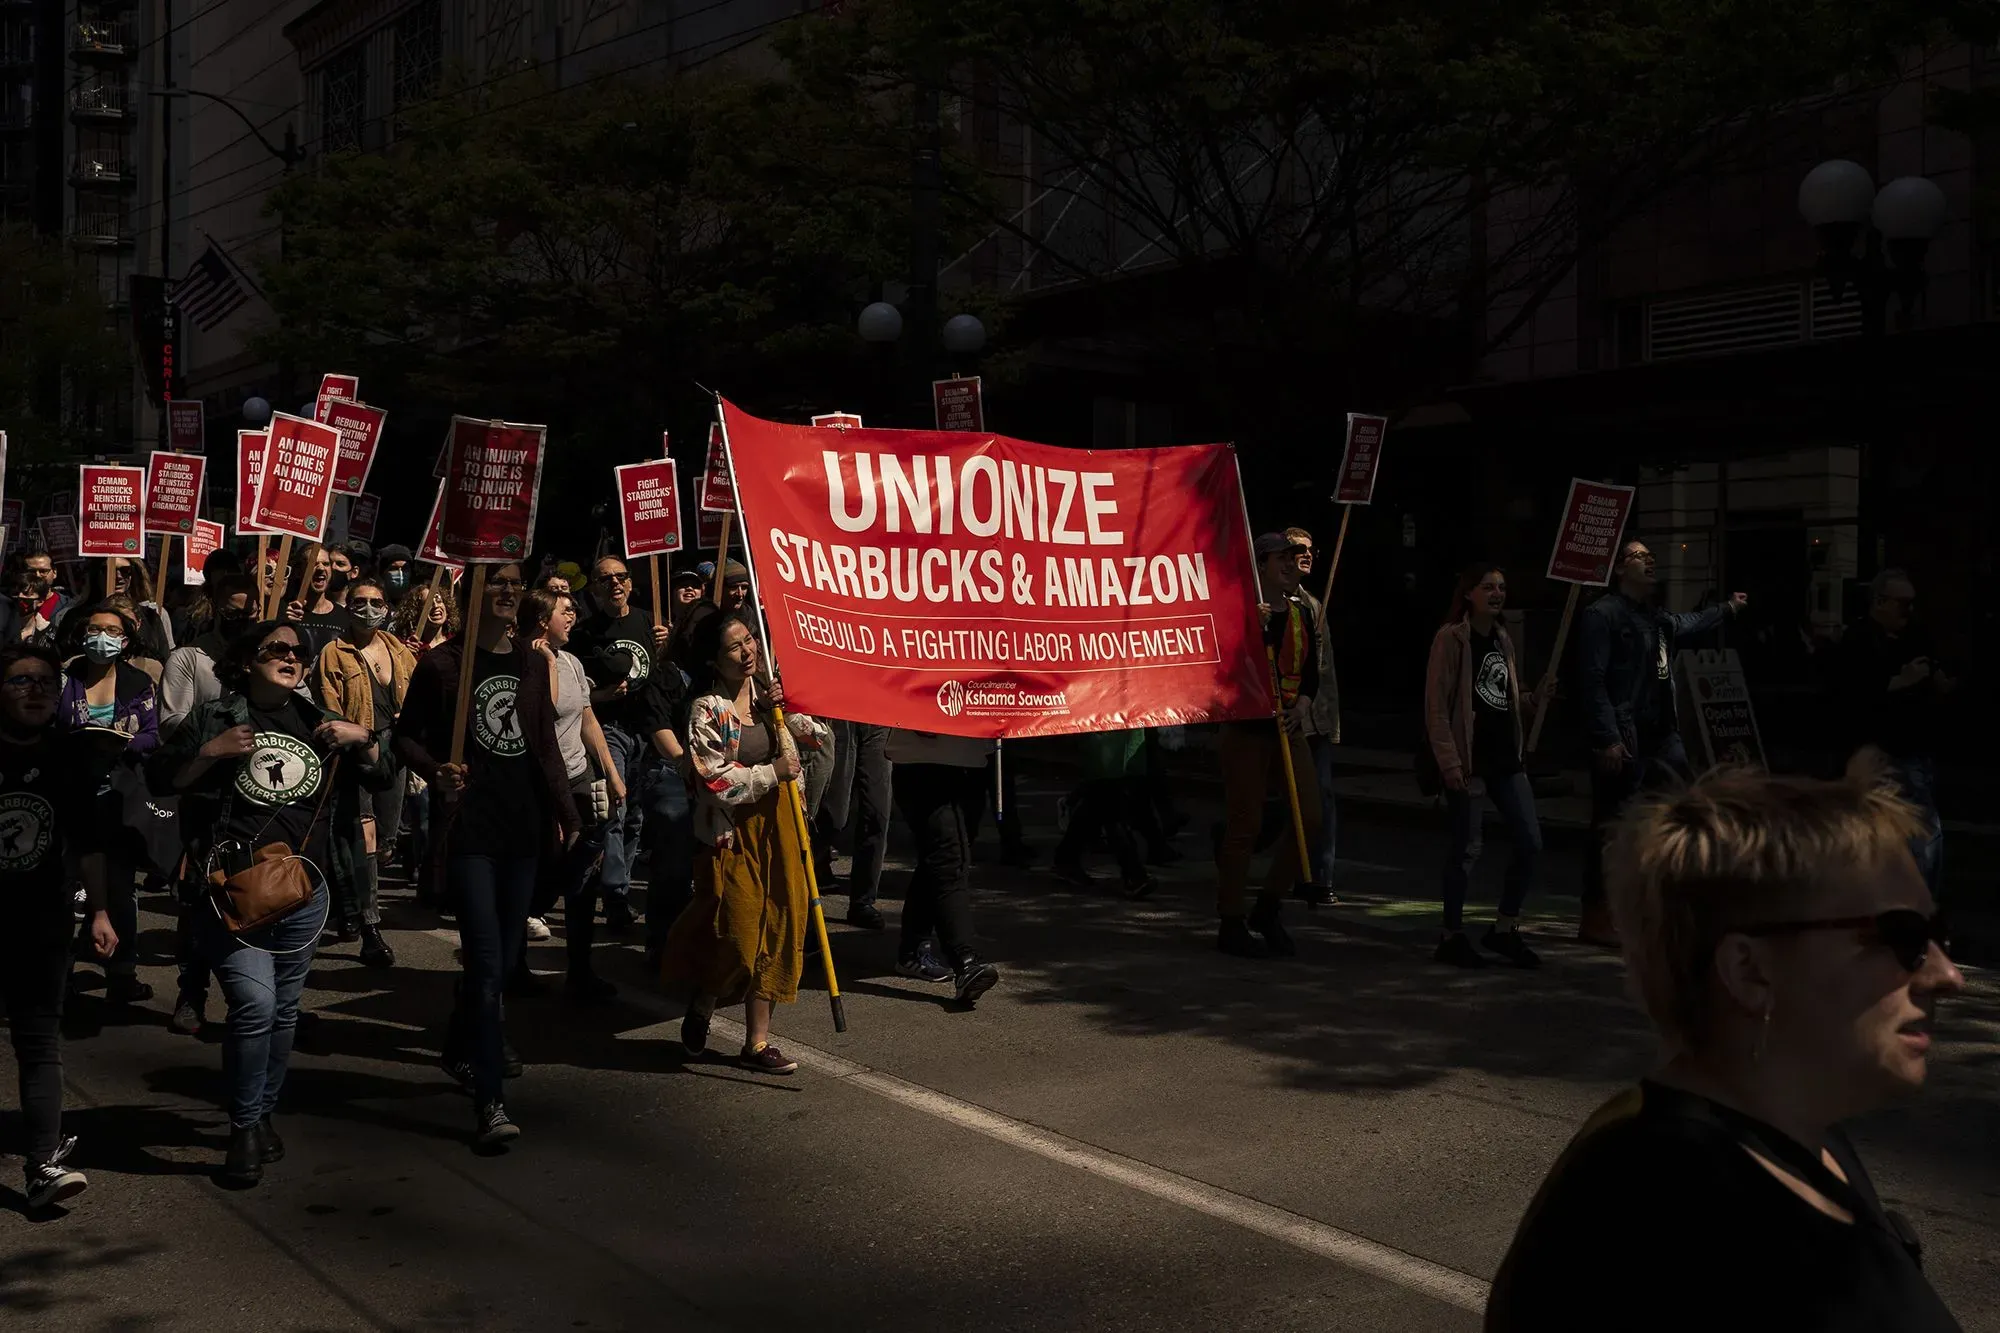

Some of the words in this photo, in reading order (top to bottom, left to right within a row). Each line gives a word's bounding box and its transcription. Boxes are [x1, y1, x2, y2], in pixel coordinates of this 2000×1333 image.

[163, 344, 172, 400] CHRIS
[326, 386, 342, 395] FIGHT
[334, 416, 366, 430] REBUILD
[365, 423, 372, 432] A
[339, 428, 368, 442] GHTING
[278, 436, 294, 450] AN
[296, 440, 329, 460] INJURY
[340, 438, 360, 450] ABOR
[248, 450, 260, 461] AN
[339, 450, 366, 462] EMENT
[464, 444, 481, 460] AN
[484, 448, 528, 464] INJURY
[164, 462, 190, 472] DEMAND
[250, 462, 261, 472] TO
[278, 450, 292, 464] TO
[294, 454, 314, 470] ONE
[315, 460, 324, 473] IS
[158, 470, 194, 480] STARBUCKS
[272, 464, 290, 478] AN
[290, 467, 324, 487] INJURY
[464, 461, 480, 477] TO
[482, 464, 508, 479] ONE
[510, 466, 522, 480] IS
[97, 477, 128, 486] DEMAND
[159, 478, 192, 488] REINSTATE
[248, 474, 260, 484] AN
[459, 476, 478, 492] AN
[480, 480, 523, 496] INJURY
[637, 478, 659, 490] FIGHT
[92, 486, 133, 494] STARBUCKS
[166, 487, 194, 496] WORKERS
[279, 478, 292, 492] TO
[293, 482, 316, 498] ALL!
[626, 486, 672, 502] STARBUCKS'
[94, 494, 131, 504] REINSTATE
[158, 494, 176, 502] FIRED
[467, 494, 482, 510] TO
[484, 496, 512, 510] ALL!
[639, 498, 662, 510] UNION
[823, 450, 1124, 545] UNIONIZE
[1587, 494, 1618, 507] DEMAND
[88, 504, 102, 512] ALL
[102, 504, 137, 512] WORKERS
[152, 502, 192, 512] ORGANIZING!
[1578, 504, 1620, 518] STARBUCKS
[94, 512, 114, 520] FIRED
[116, 513, 130, 521] FOR
[634, 508, 669, 521] BUSTING!
[1578, 514, 1614, 528] REINSTATE
[90, 521, 134, 530] ORGANIZING!
[1570, 522, 1584, 532] ALL
[1584, 524, 1616, 536] WORKERS
[1573, 533, 1594, 545] FIRED
[1595, 537, 1608, 546] FOR
[1565, 542, 1610, 556] ORGANIZING!
[771, 528, 1004, 603] STARBUCKS
[1012, 553, 1036, 606] &
[1045, 552, 1210, 607] AMAZON
[795, 609, 876, 655] REBUILD
[883, 628, 898, 658] A
[902, 629, 1009, 660] FIGHTING
[1013, 632, 1073, 662] LABOR
[1079, 626, 1204, 661] MOVEMENT
[480, 680, 516, 700] STARBU
[967, 680, 1016, 690] Councilmember
[966, 690, 1015, 706] Kshama
[1018, 691, 1066, 706] Sawant
[255, 736, 308, 757] ARBUCKS
[238, 772, 277, 801] ORKERS
[0, 798, 48, 820] RBUCKS
[21, 832, 48, 865] UNITED
